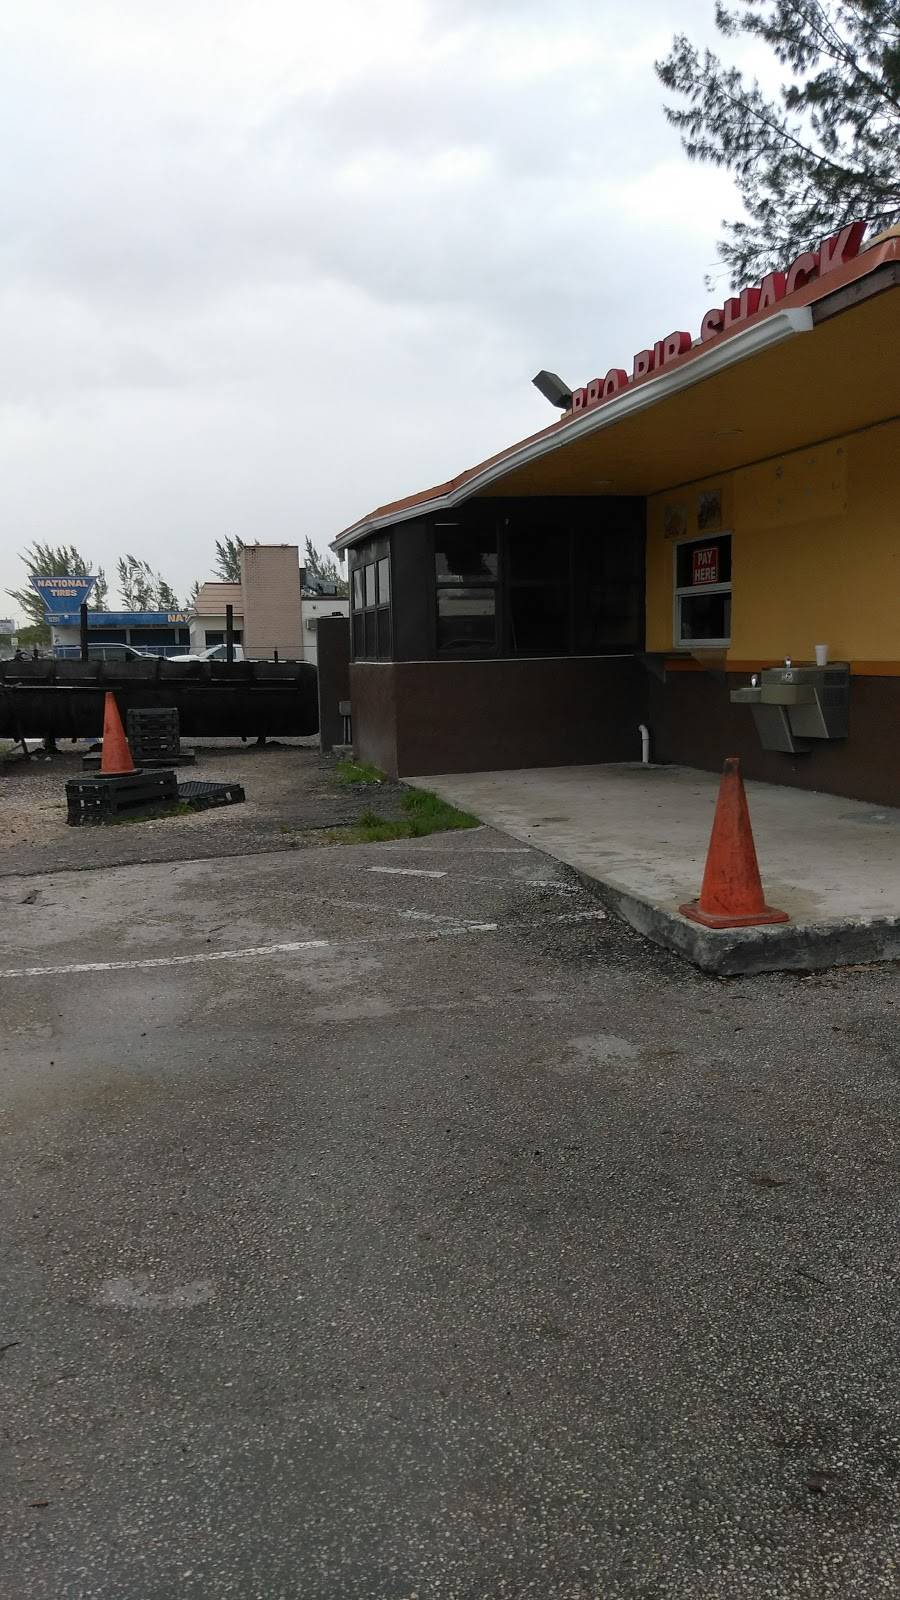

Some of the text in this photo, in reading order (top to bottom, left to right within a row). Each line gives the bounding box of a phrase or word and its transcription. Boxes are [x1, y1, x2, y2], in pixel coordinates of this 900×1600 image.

[701, 221, 868, 343] SHACK
[698, 551, 713, 566] PAY
[695, 567, 717, 581] HERE
[37, 579, 88, 588] NATIONAL
[51, 589, 78, 597] TIRES
